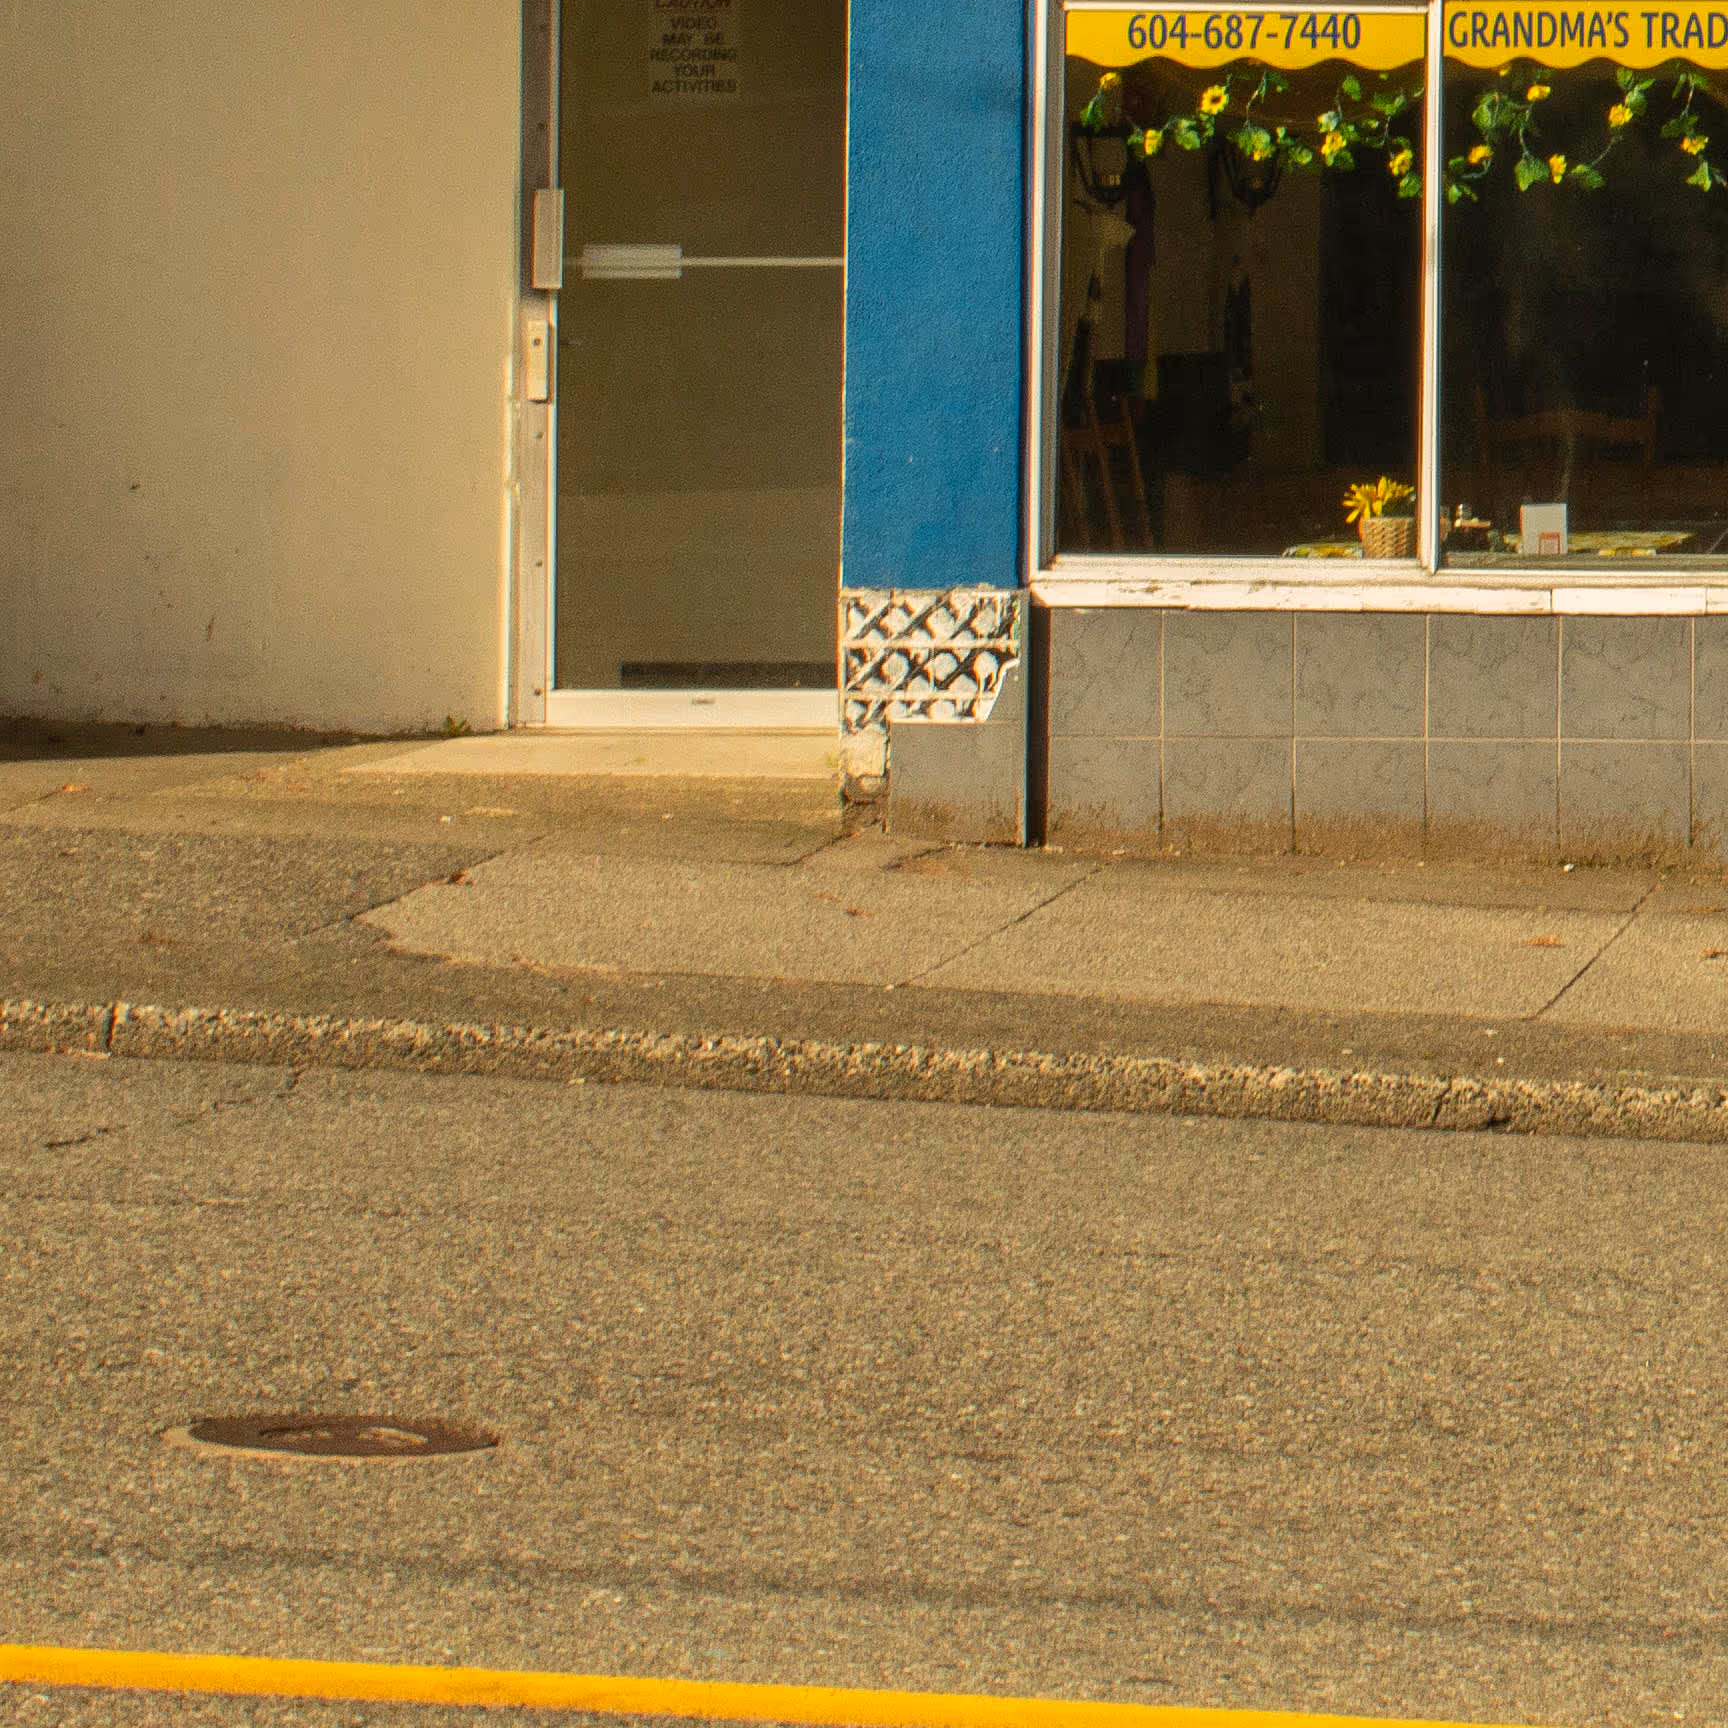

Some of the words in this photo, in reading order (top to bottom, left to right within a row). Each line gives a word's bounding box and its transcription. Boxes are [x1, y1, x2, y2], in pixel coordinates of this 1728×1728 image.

[670, 16, 717, 29] VIDEO
[1127, 12, 1361, 50] 604-687-7440
[1449, 11, 1630, 48] GRANDMA'S
[662, 32, 693, 45] MAY
[650, 48, 737, 62] RECORDING
[672, 64, 715, 77] YOUR
